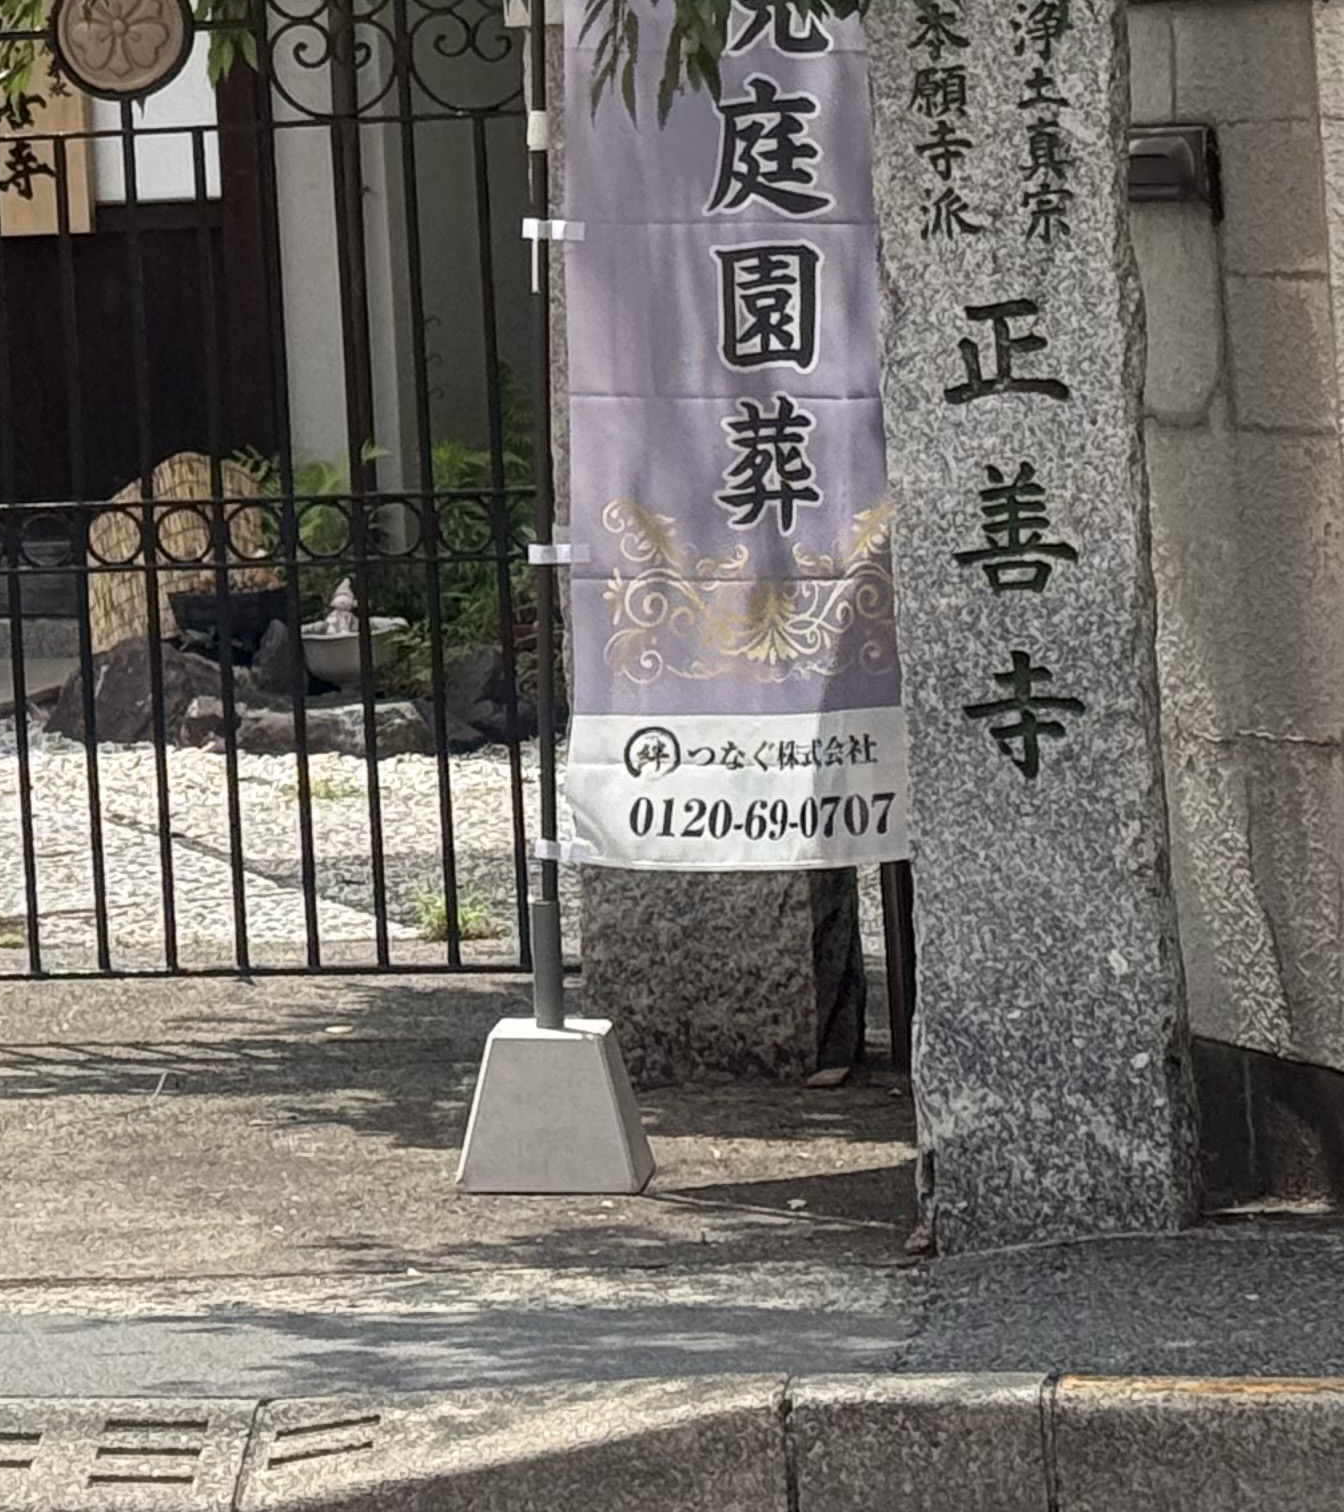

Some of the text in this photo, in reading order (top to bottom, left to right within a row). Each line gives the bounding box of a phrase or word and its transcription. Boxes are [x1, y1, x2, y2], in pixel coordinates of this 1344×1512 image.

[908, 2, 981, 240] 本願寺派
[1011, 0, 1074, 244] 浄土真宗
[944, 298, 1085, 780] 正善寺
[630, 792, 896, 840] 0120-69-0707
[688, 734, 878, 771] つなぐ株式会社
